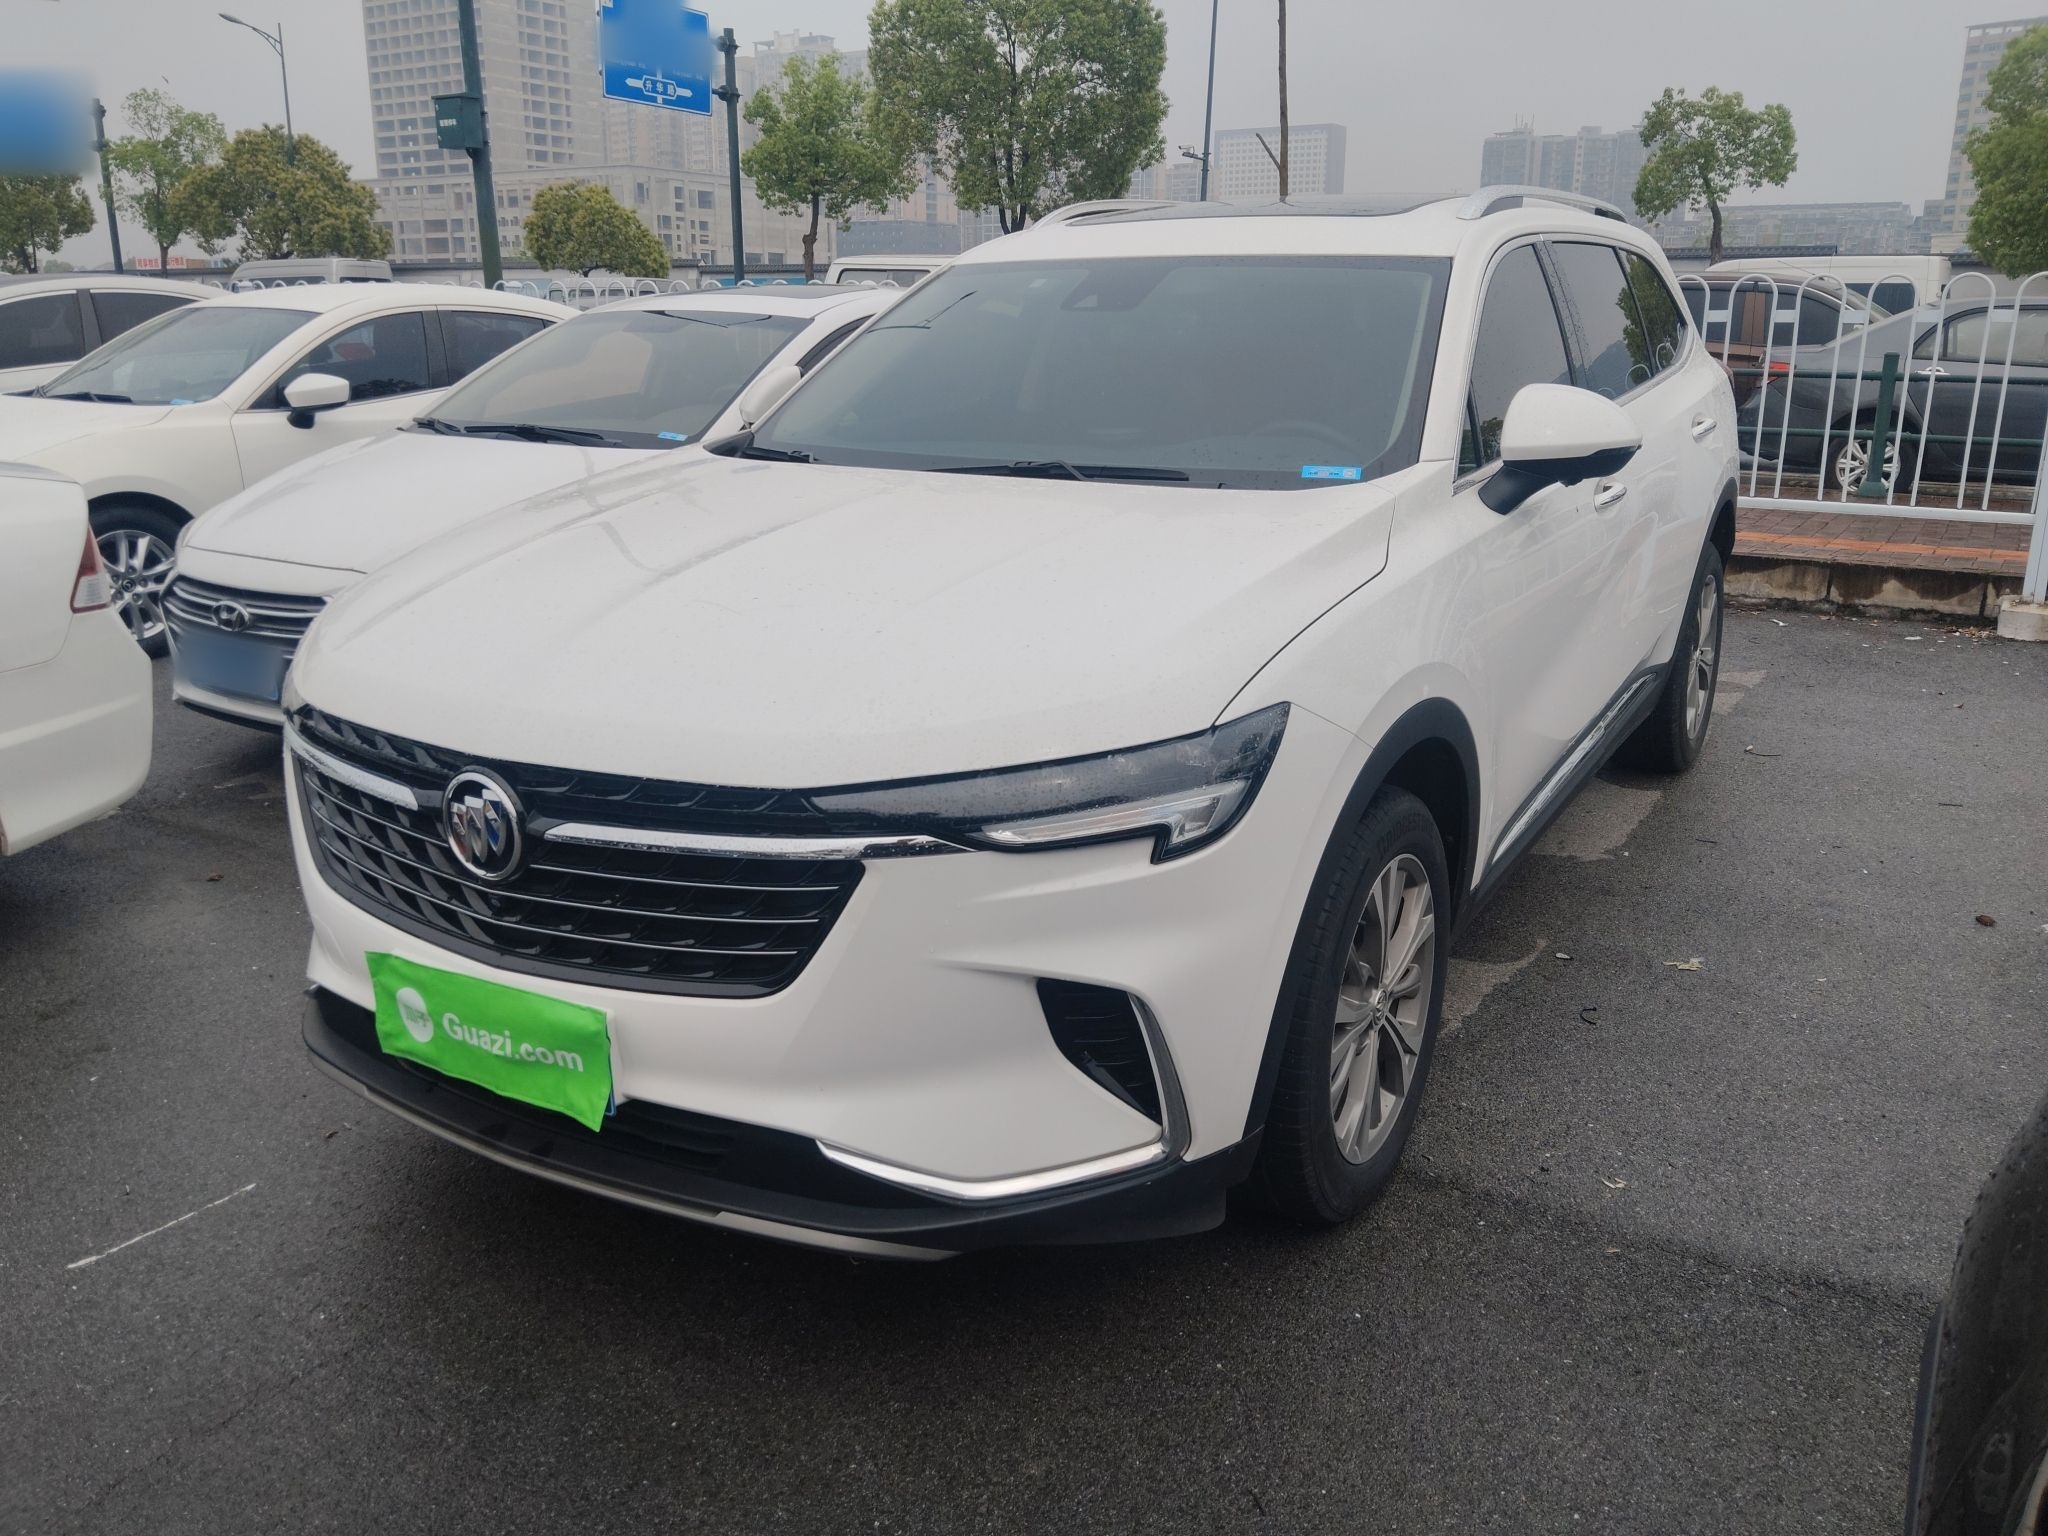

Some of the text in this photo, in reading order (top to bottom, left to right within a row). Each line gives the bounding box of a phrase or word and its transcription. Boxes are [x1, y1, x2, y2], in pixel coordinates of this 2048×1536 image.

[644, 80, 675, 96] 升华路
[442, 1013, 584, 1072] Guazi.com
